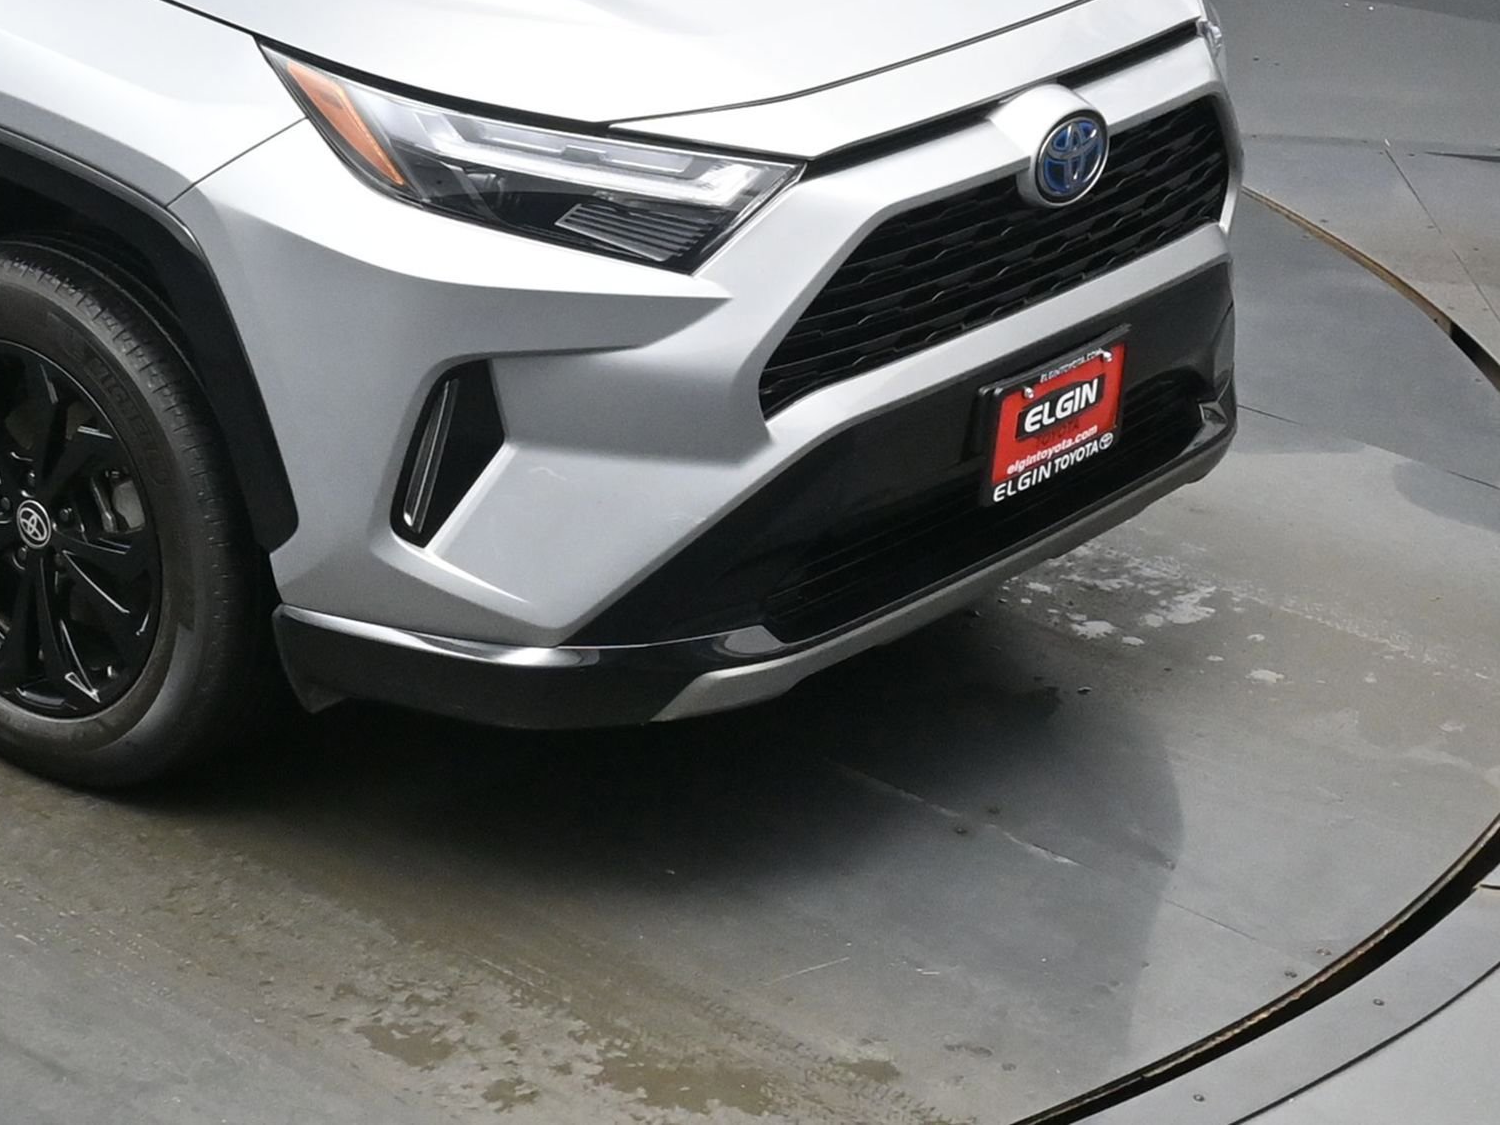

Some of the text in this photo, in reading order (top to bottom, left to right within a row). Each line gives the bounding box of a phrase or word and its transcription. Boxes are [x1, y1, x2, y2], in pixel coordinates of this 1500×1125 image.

[1024, 378, 1099, 433] ELGIN
[993, 439, 1099, 503] ELGIN TOYOTA
[1006, 425, 1098, 474] elgintoyota.com
